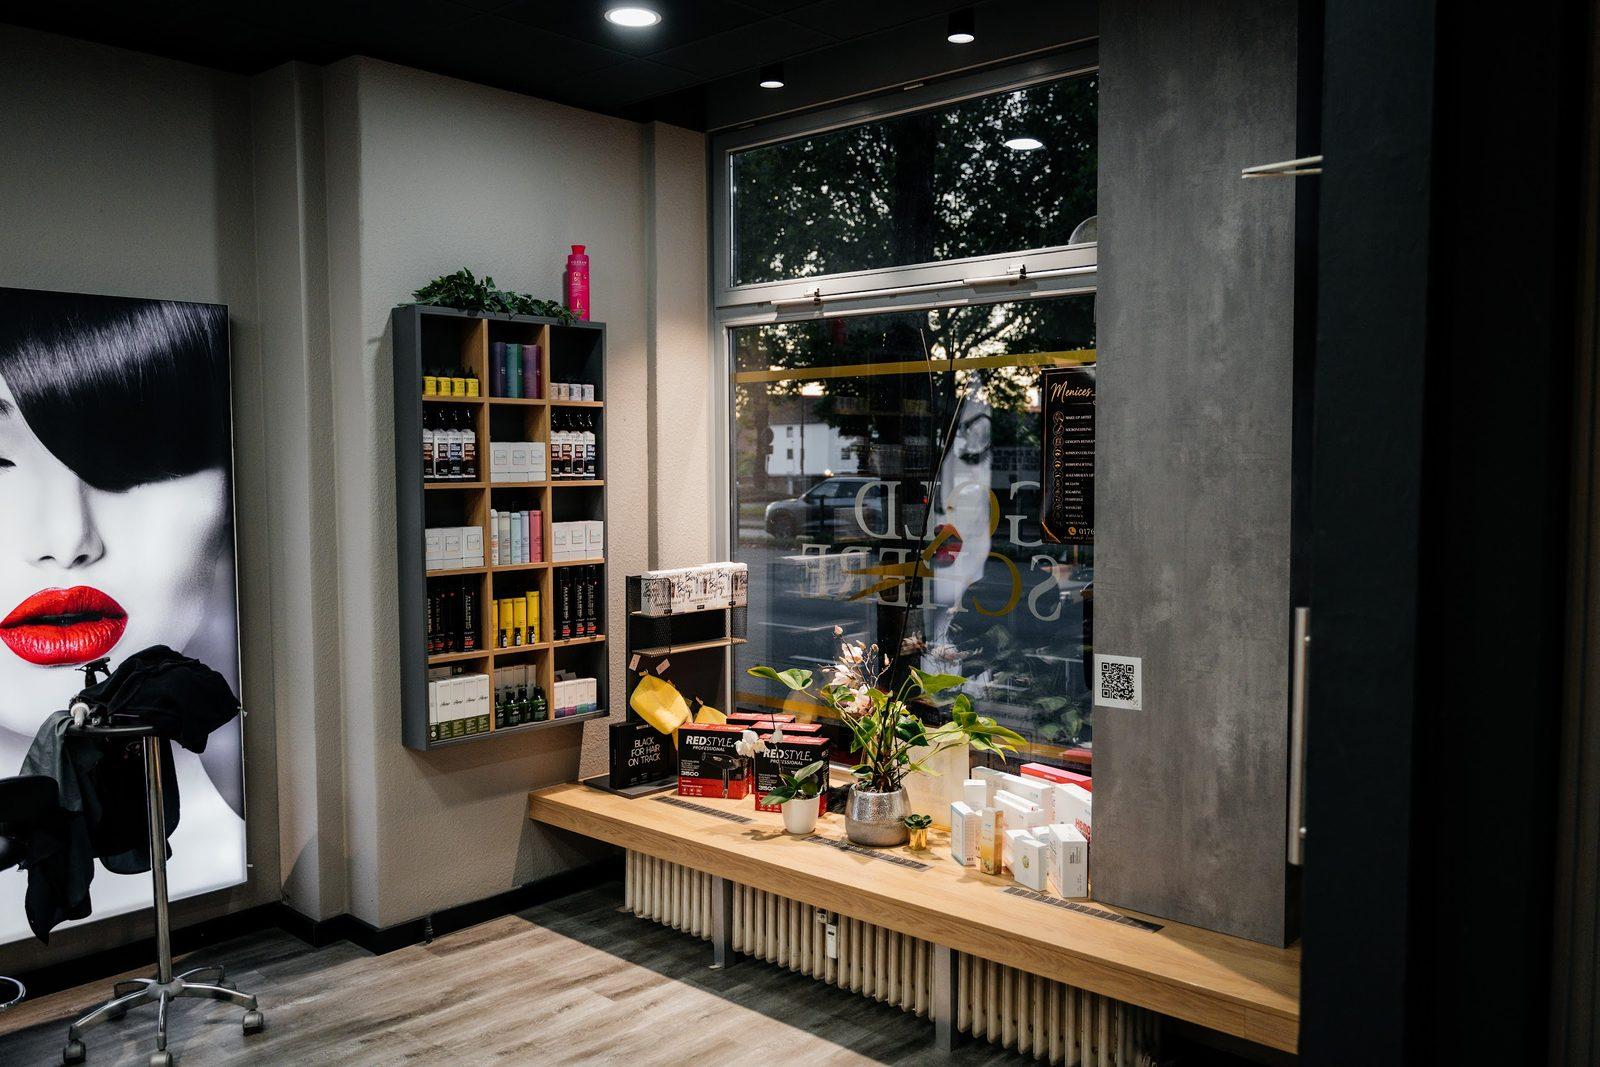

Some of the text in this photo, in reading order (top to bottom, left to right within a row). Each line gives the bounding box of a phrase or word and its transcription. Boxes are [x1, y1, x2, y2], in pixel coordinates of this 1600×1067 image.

[1050, 380, 1092, 403] Menices
[634, 736, 655, 748] BLACK
[631, 743, 660, 757] FOR HAIR
[628, 752, 661, 767] ON TRACK
